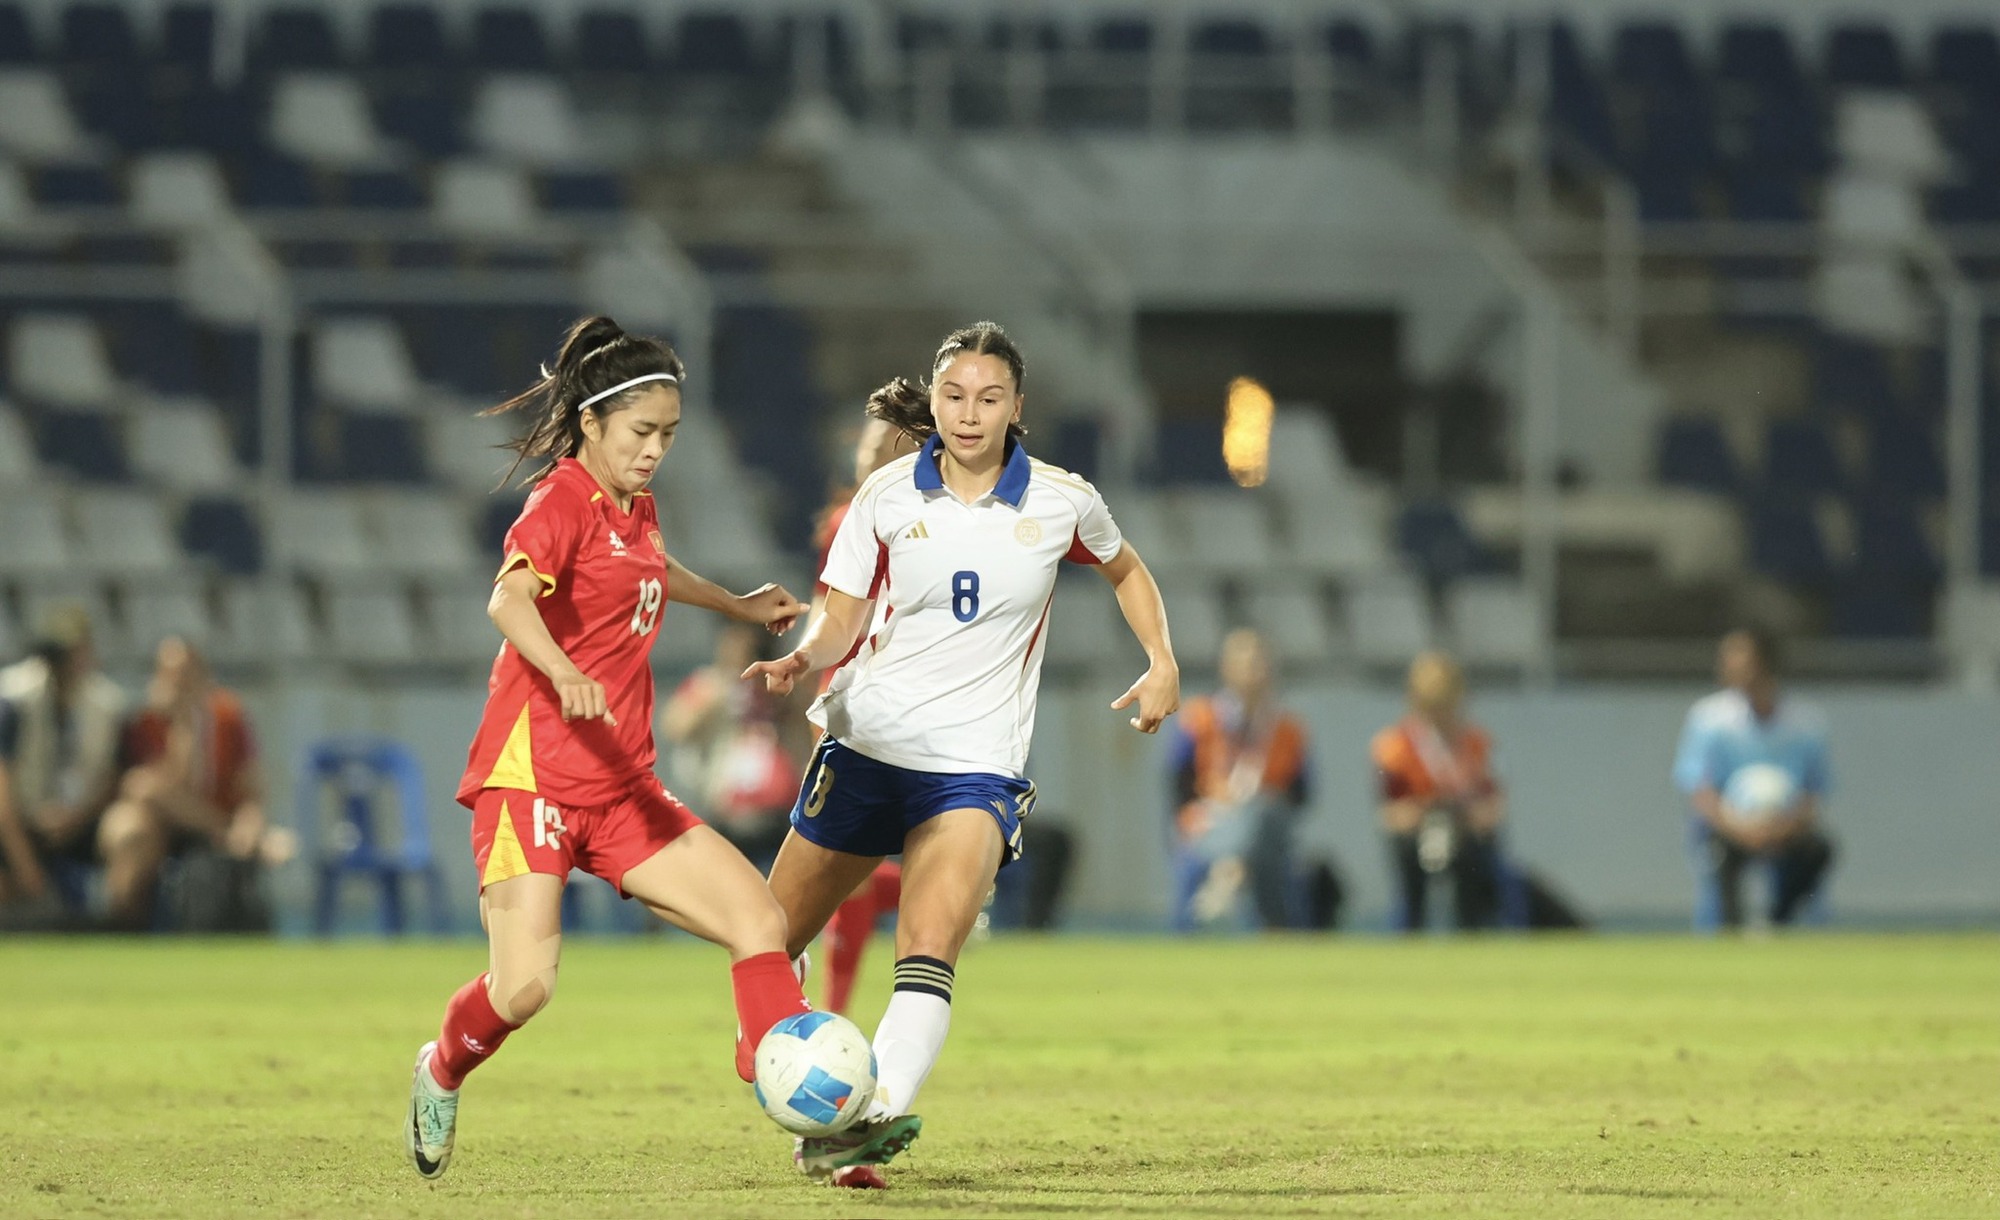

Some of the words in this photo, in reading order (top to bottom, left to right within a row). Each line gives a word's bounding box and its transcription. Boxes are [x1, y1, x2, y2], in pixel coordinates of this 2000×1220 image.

[631, 577, 662, 637] 19
[952, 570, 980, 623] 8
[803, 763, 835, 818] 8
